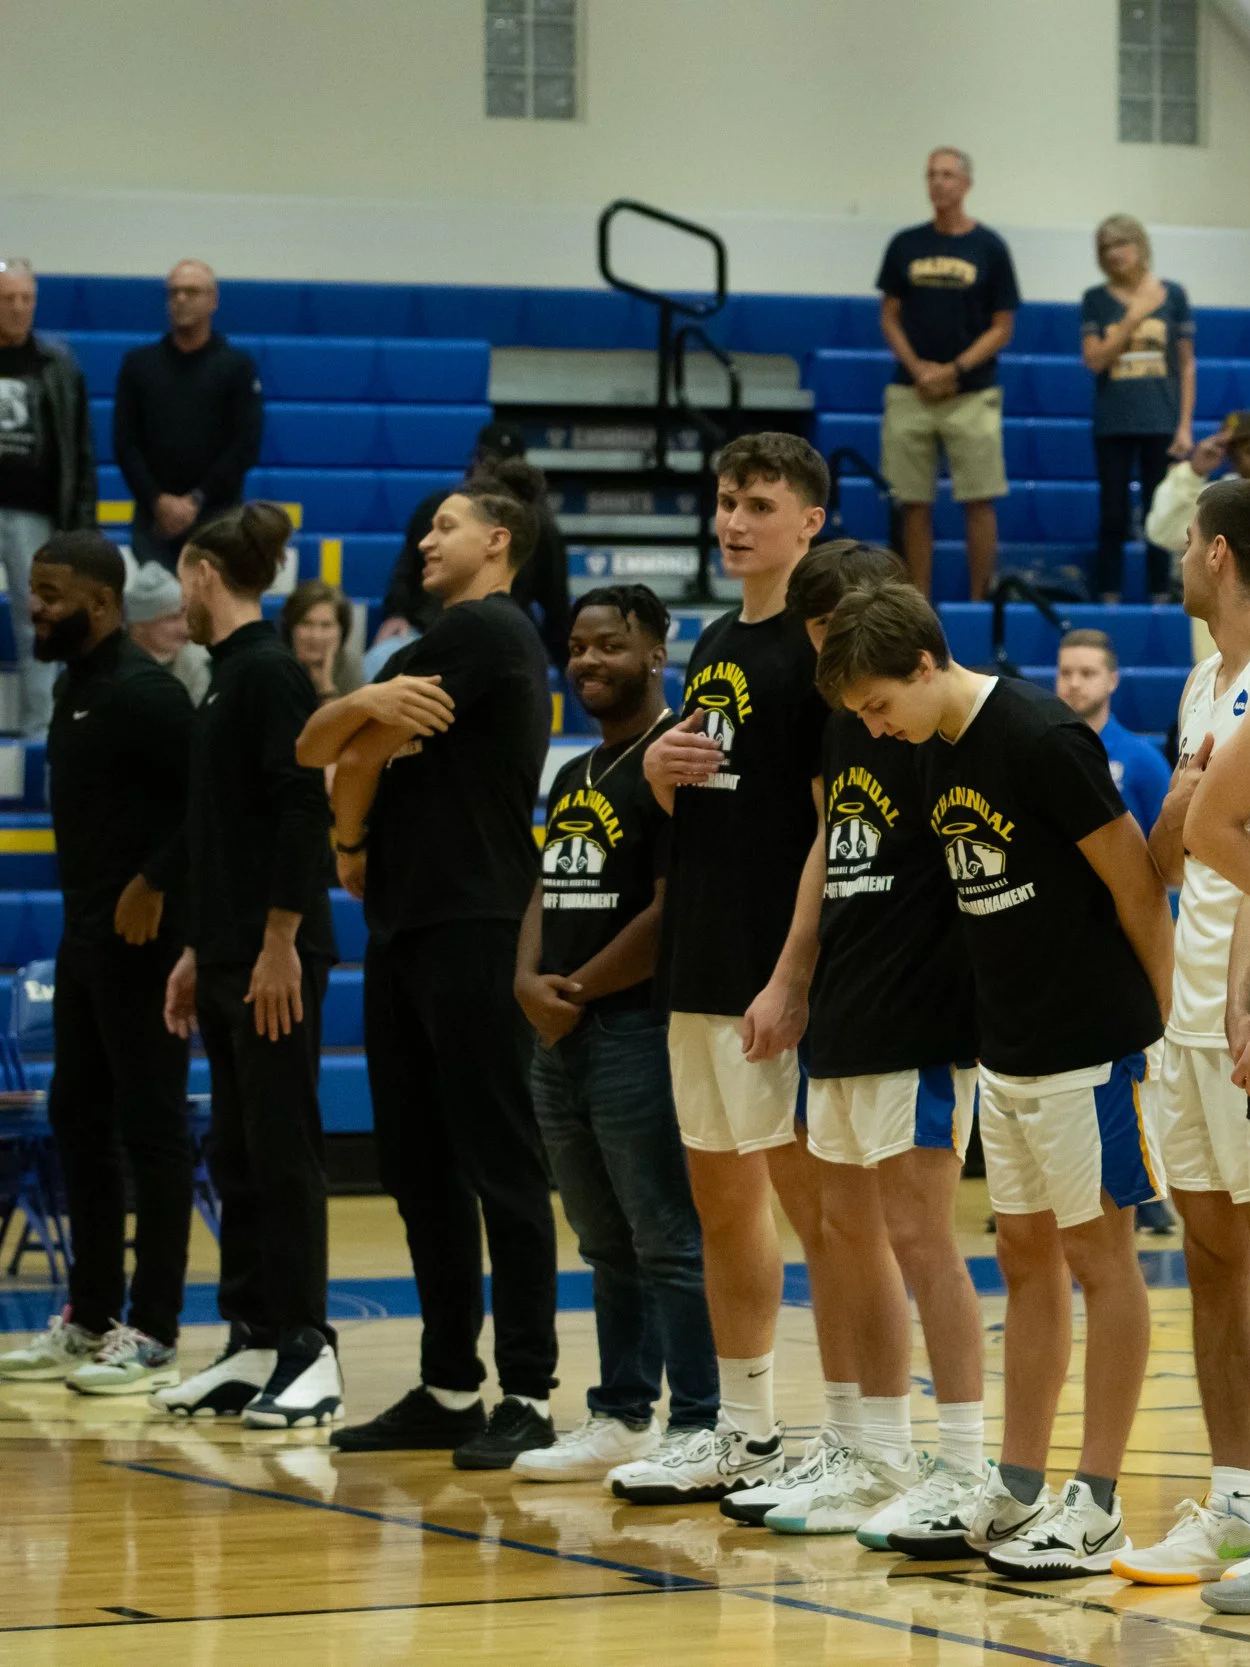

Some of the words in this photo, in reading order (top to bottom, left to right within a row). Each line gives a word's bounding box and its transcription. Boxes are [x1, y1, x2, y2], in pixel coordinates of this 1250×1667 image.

[712, 661, 753, 724] ANNUAL
[572, 789, 624, 848] ANNUAL
[847, 766, 900, 828] ANNUAL
[947, 785, 1016, 842] ANNUAL
